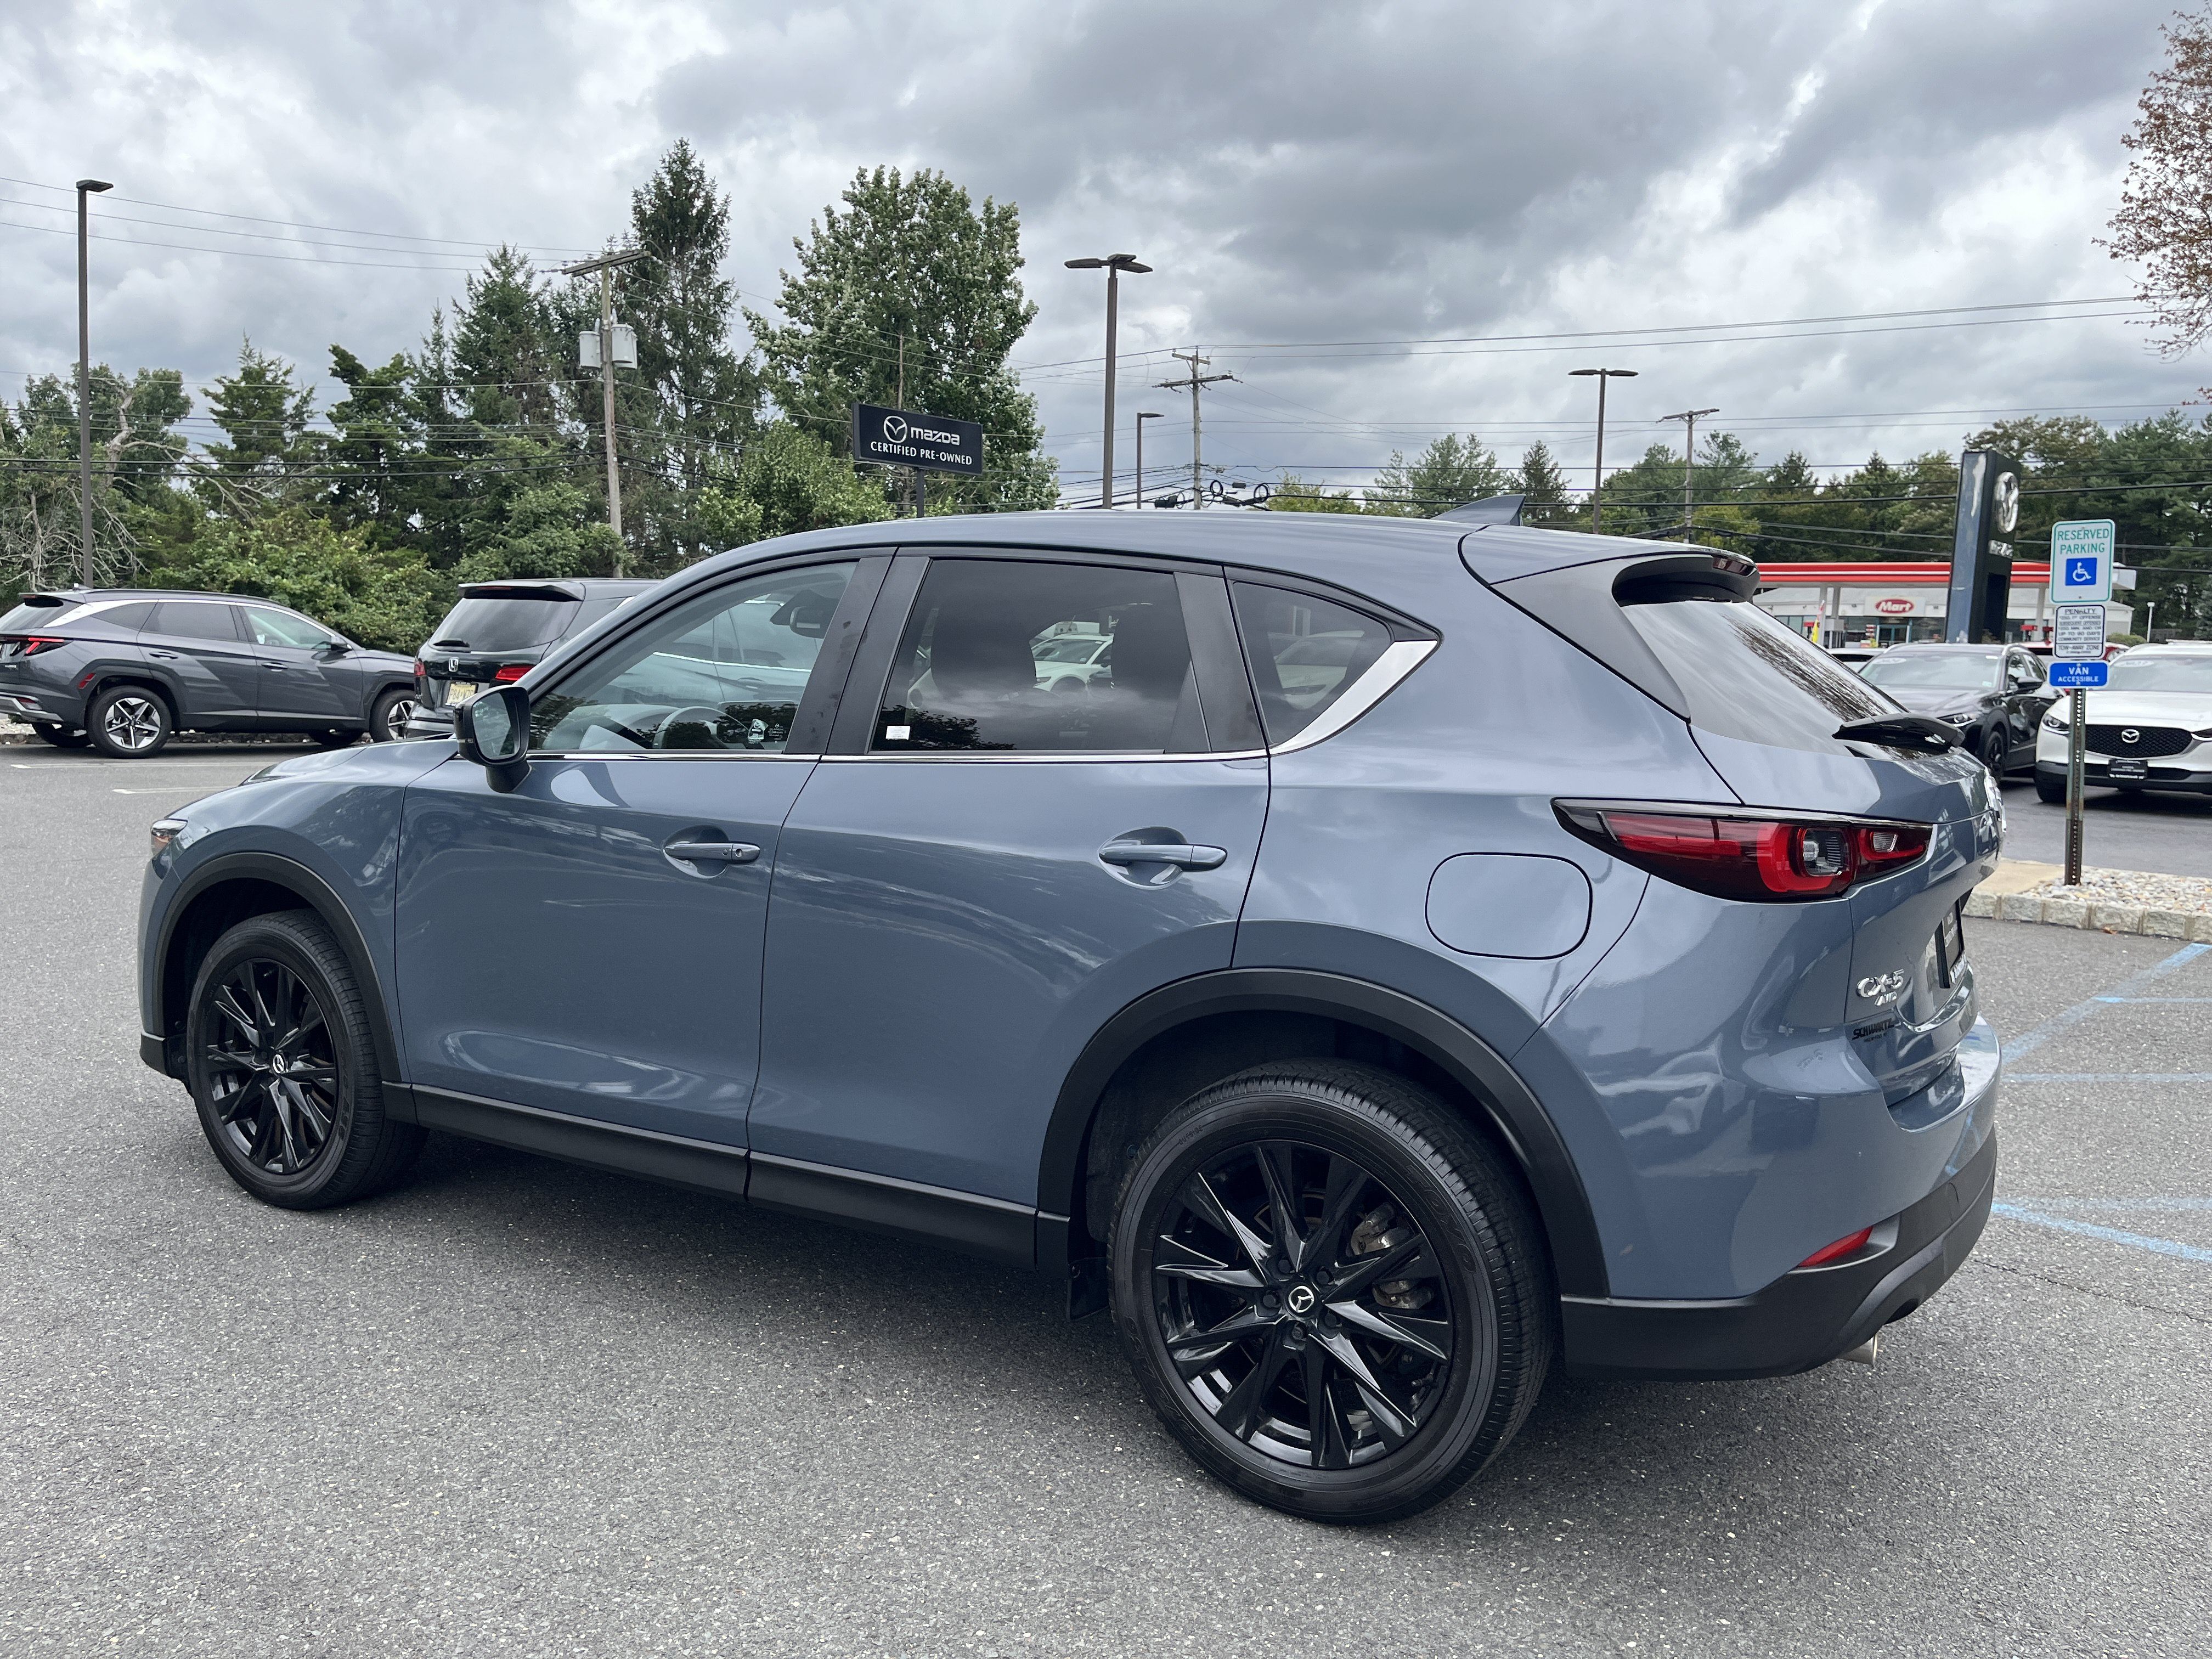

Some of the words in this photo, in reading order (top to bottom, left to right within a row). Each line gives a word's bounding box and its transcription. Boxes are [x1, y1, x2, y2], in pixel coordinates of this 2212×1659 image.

[870, 441, 917, 457] CERTIFIED
[920, 448, 973, 465] PRE-OWNED
[2057, 528, 2109, 541] RESERVED
[2060, 543, 2105, 554] PARKING
[1878, 601, 1911, 612] Mart
[2068, 667, 2089, 675] VAN
[1856, 968, 1904, 997] CX-5
[1406, 1165, 1477, 1273] TOYO
